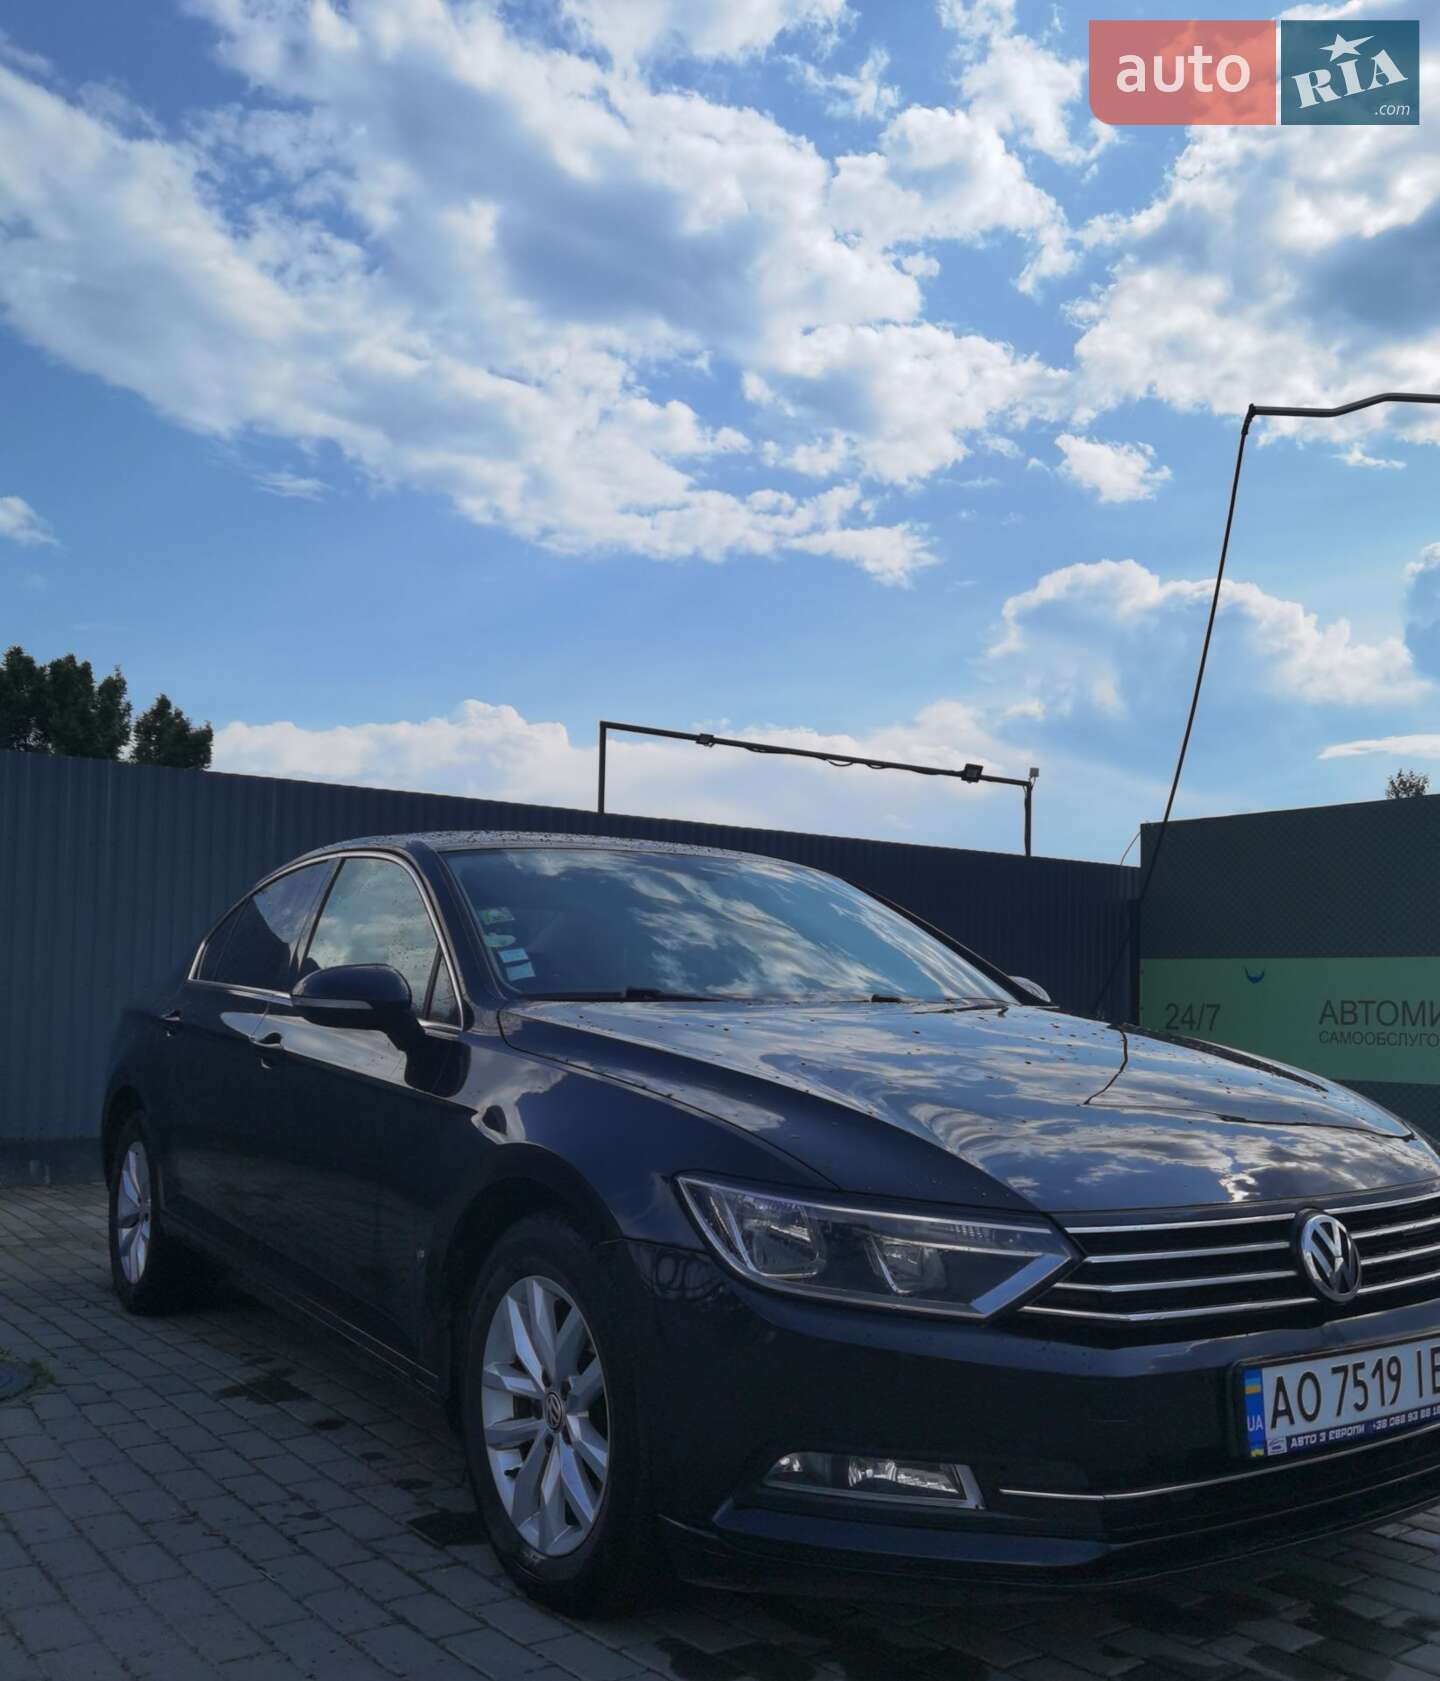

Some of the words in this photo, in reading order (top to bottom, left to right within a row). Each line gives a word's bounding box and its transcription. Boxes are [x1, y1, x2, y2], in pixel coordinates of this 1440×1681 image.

[1165, 1002, 1221, 1031] 24/7
[1270, 1371, 1322, 1430] AO
[1331, 1355, 1402, 1417] 7519
[1247, 1415, 1264, 1432] UA
[1290, 1434, 1317, 1449] АВТО
